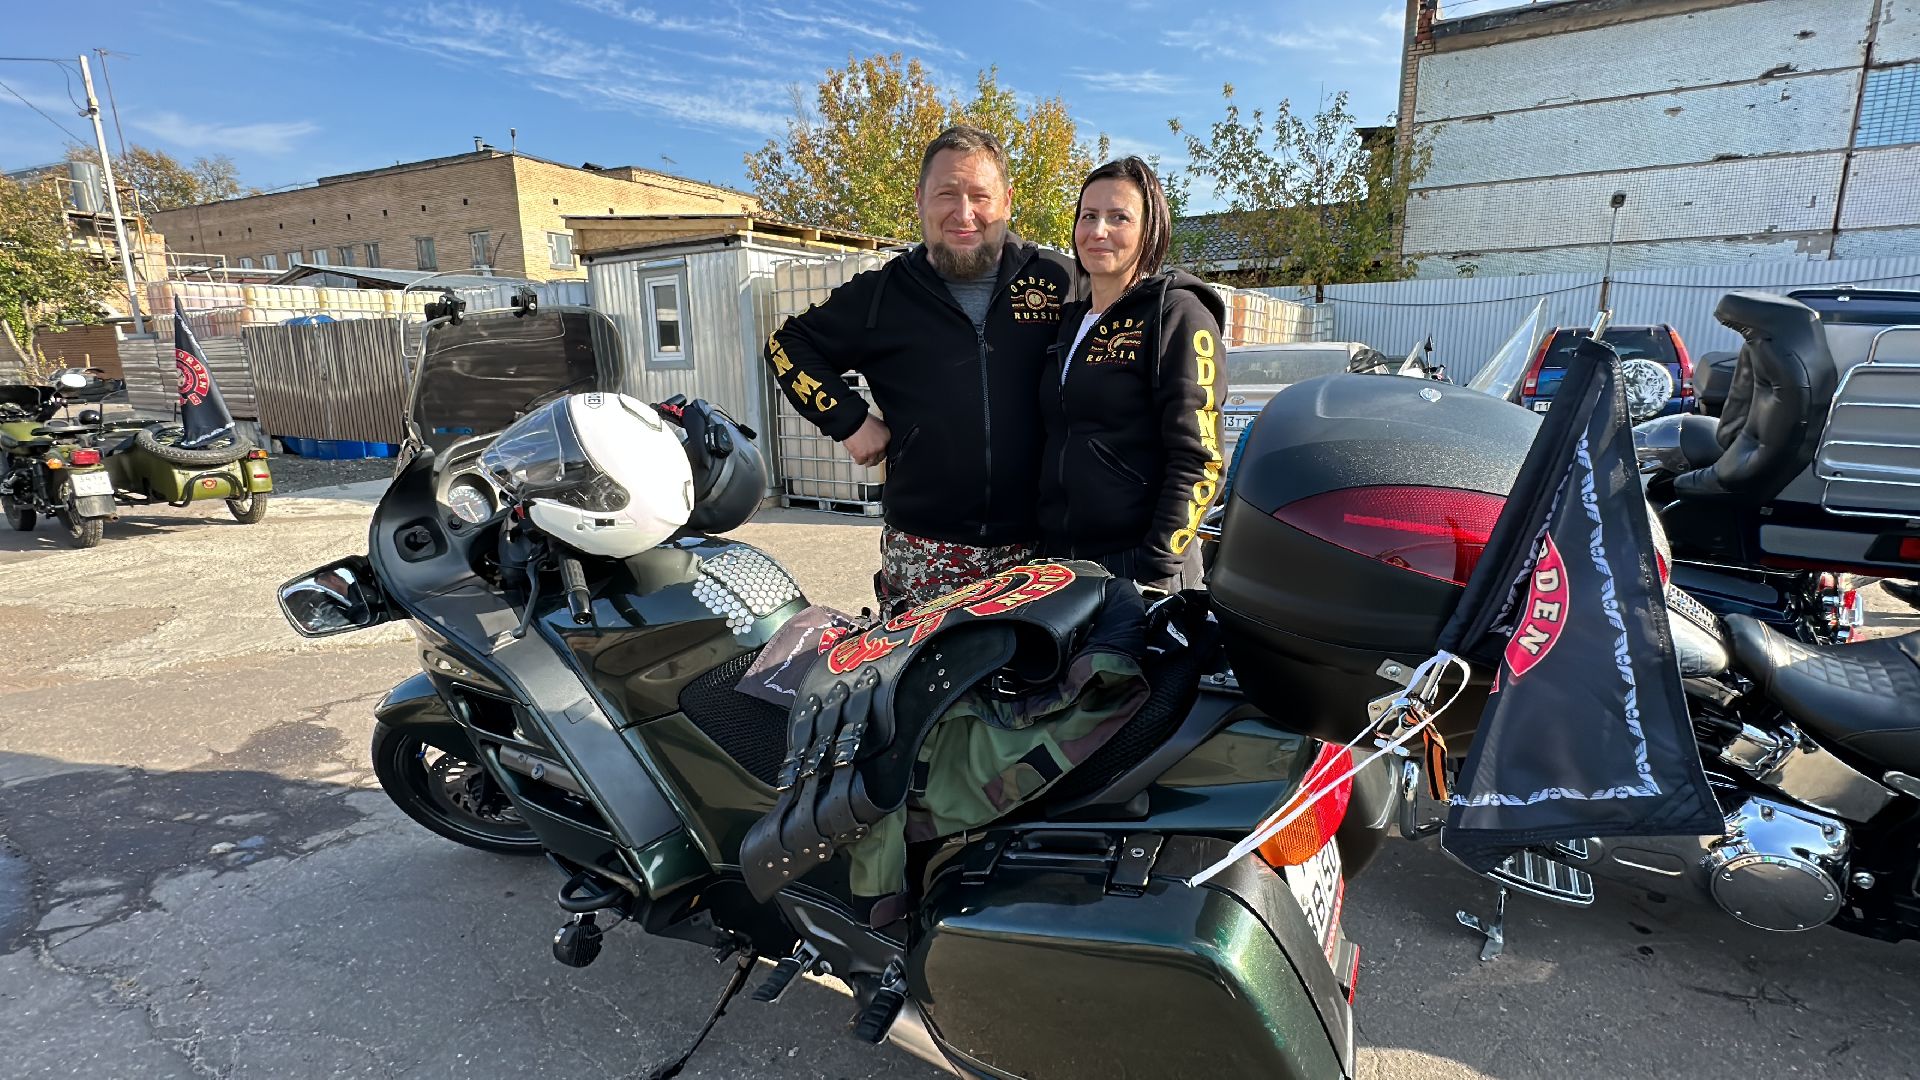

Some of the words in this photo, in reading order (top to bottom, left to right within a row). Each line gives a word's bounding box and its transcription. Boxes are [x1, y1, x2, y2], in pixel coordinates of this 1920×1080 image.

[1010, 276, 1057, 293] ORDEN
[1014, 312, 1060, 321] RUSSIA
[178, 351, 208, 389] ORDEN
